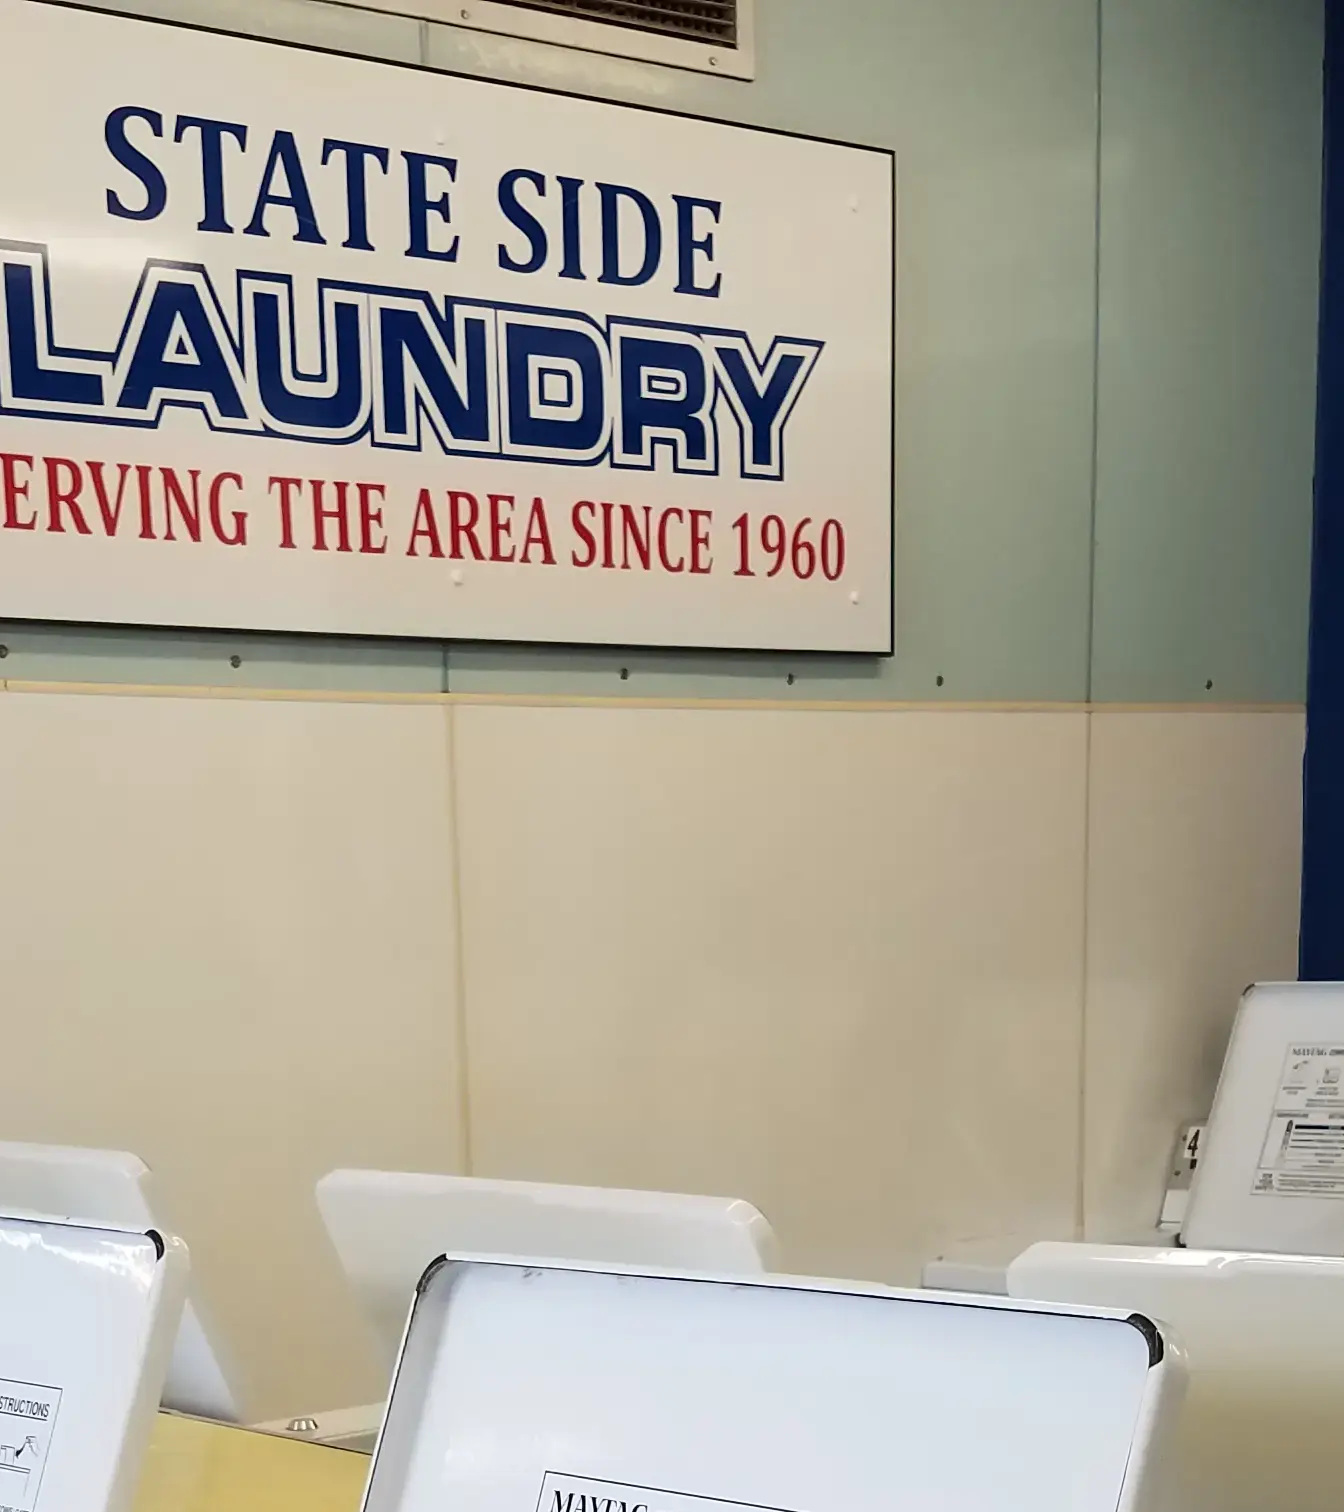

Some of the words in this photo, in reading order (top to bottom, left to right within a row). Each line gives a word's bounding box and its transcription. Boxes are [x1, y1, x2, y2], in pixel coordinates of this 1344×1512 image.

[102, 104, 460, 264] STATE
[496, 169, 724, 298] SIDE
[268, 476, 388, 554] THE
[406, 487, 558, 565] AREA
[571, 500, 714, 574] SINCE
[731, 512, 845, 580] 1960
